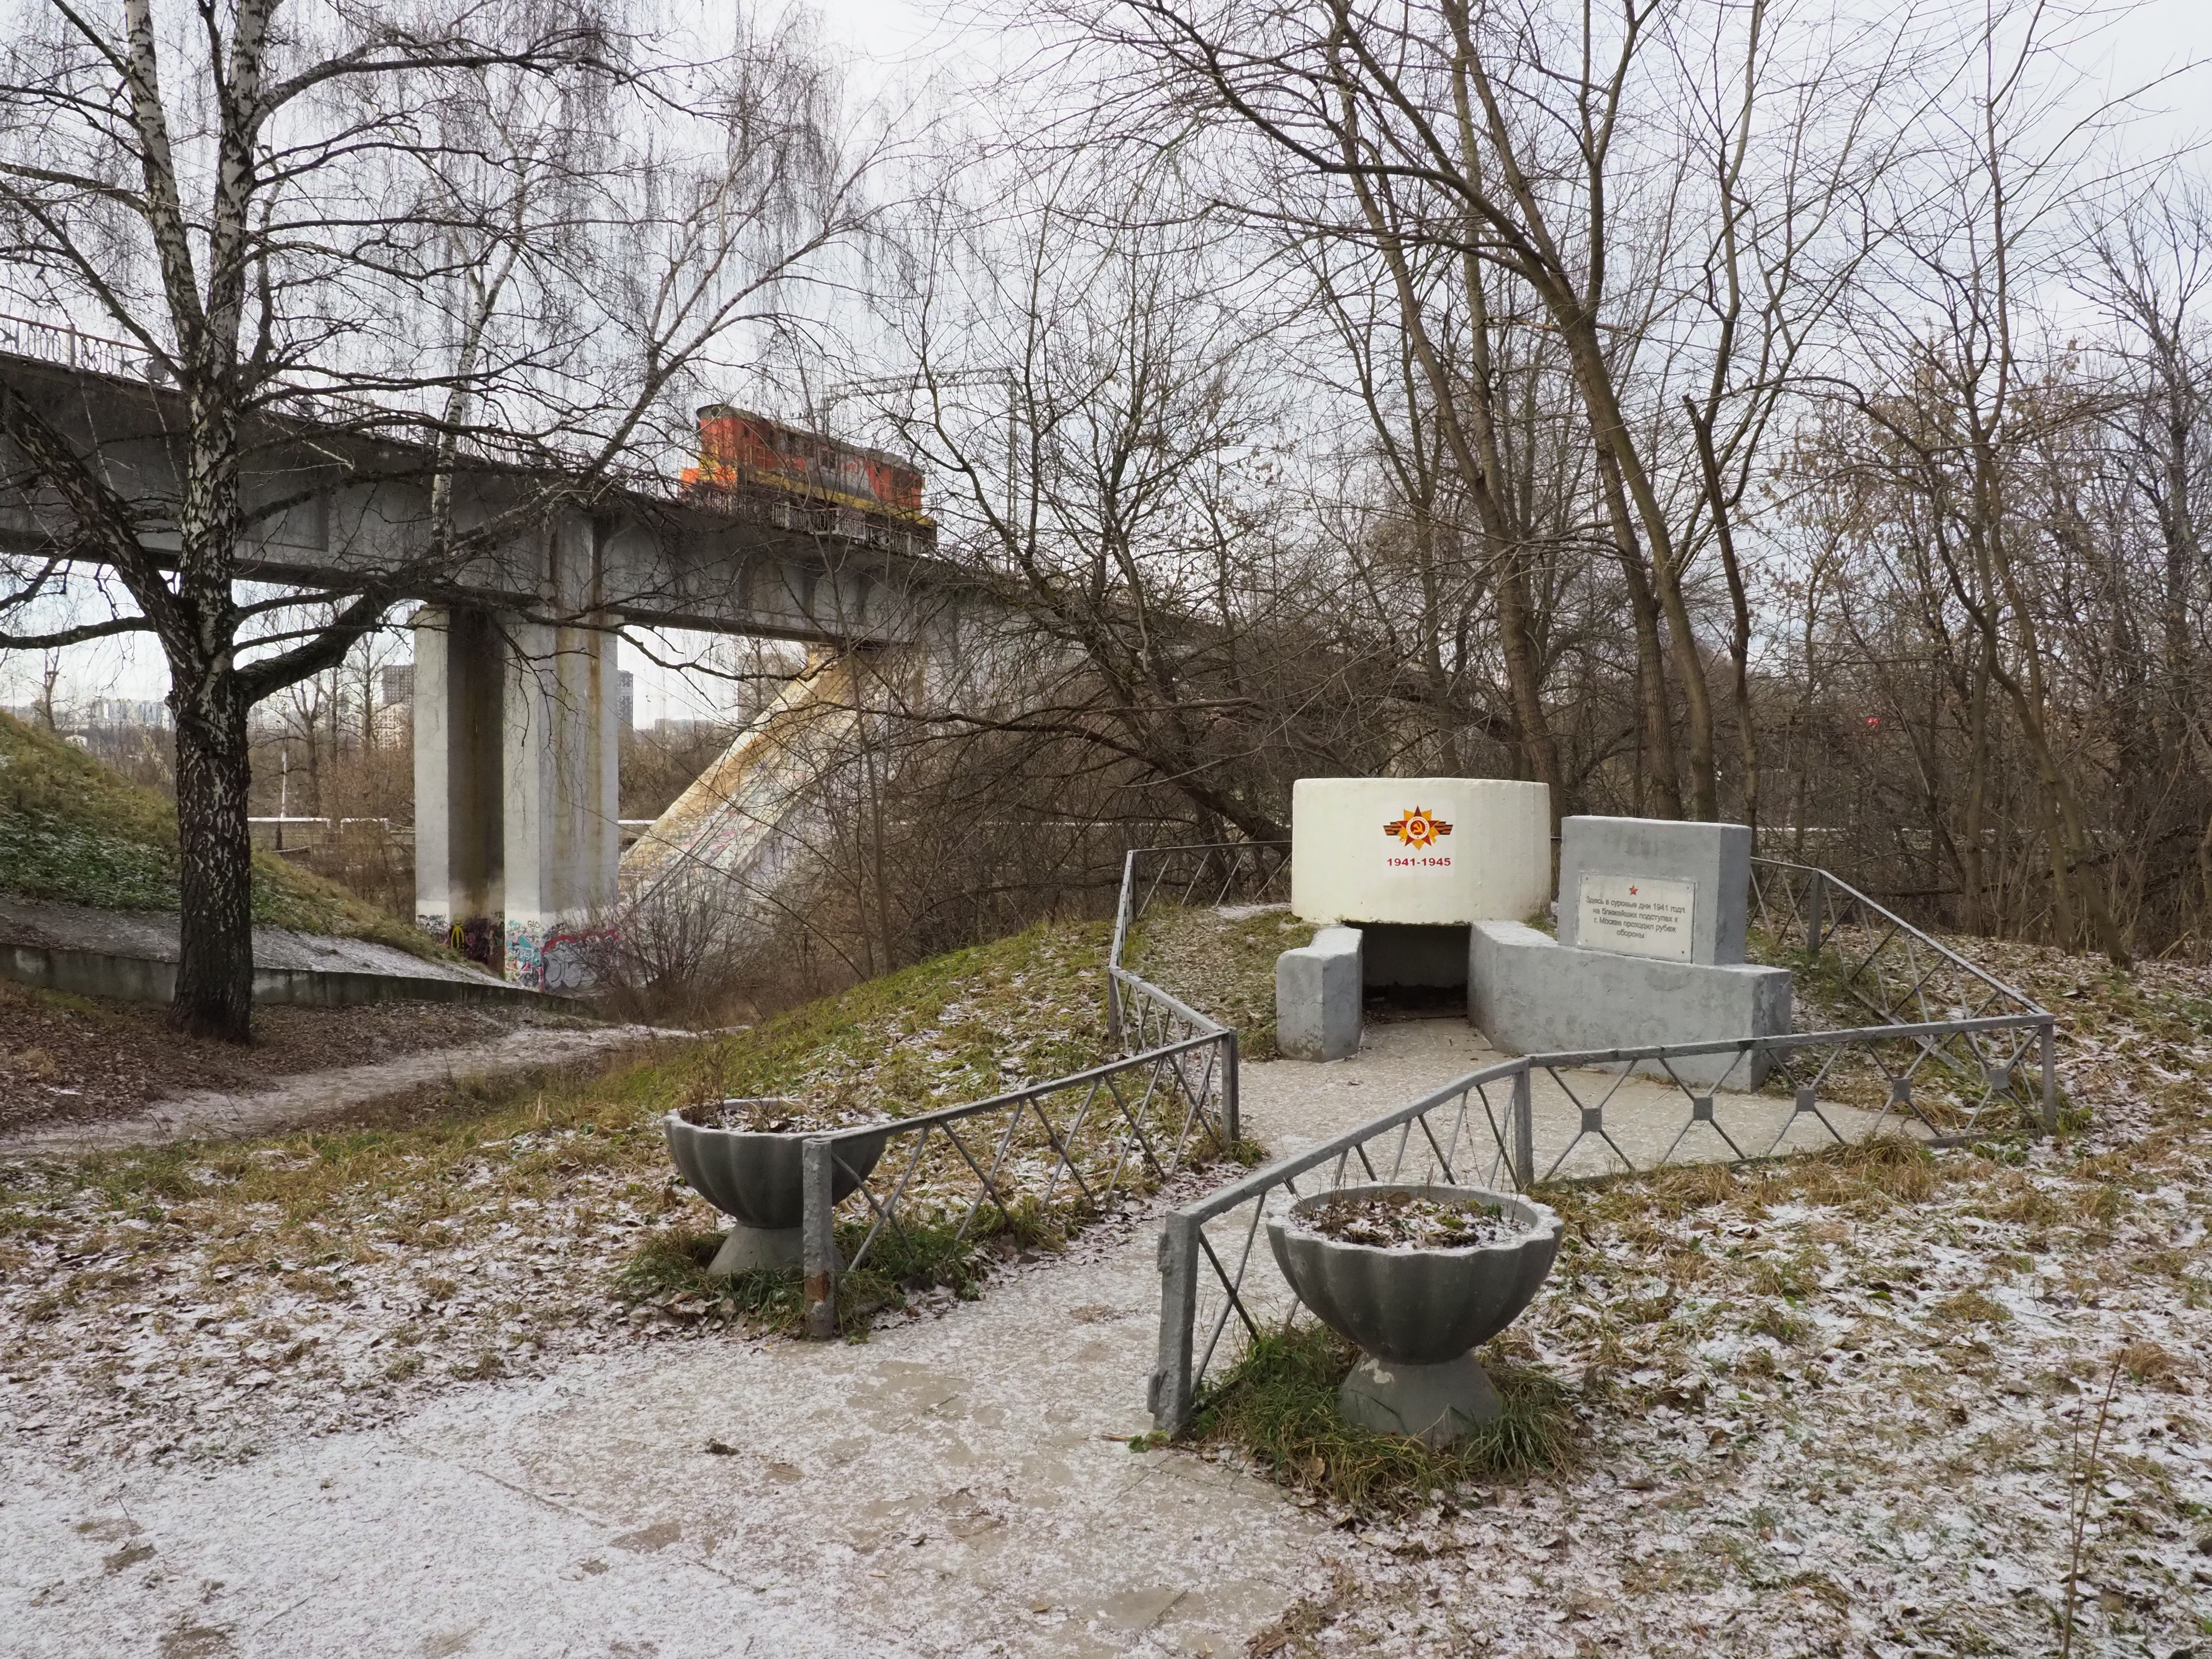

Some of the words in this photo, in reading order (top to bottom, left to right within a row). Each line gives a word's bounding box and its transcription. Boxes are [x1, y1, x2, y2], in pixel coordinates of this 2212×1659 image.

[1387, 858, 1451, 866] 1941-1945
[1586, 896, 1604, 904] Здесь
[1653, 903, 1668, 911] 1941
[1602, 908, 1638, 918] ближайших
[1639, 914, 1673, 923] подступах
[1599, 917, 1622, 926] Москве
[1624, 921, 1654, 930] проходил
[1617, 929, 1644, 938] обороны
